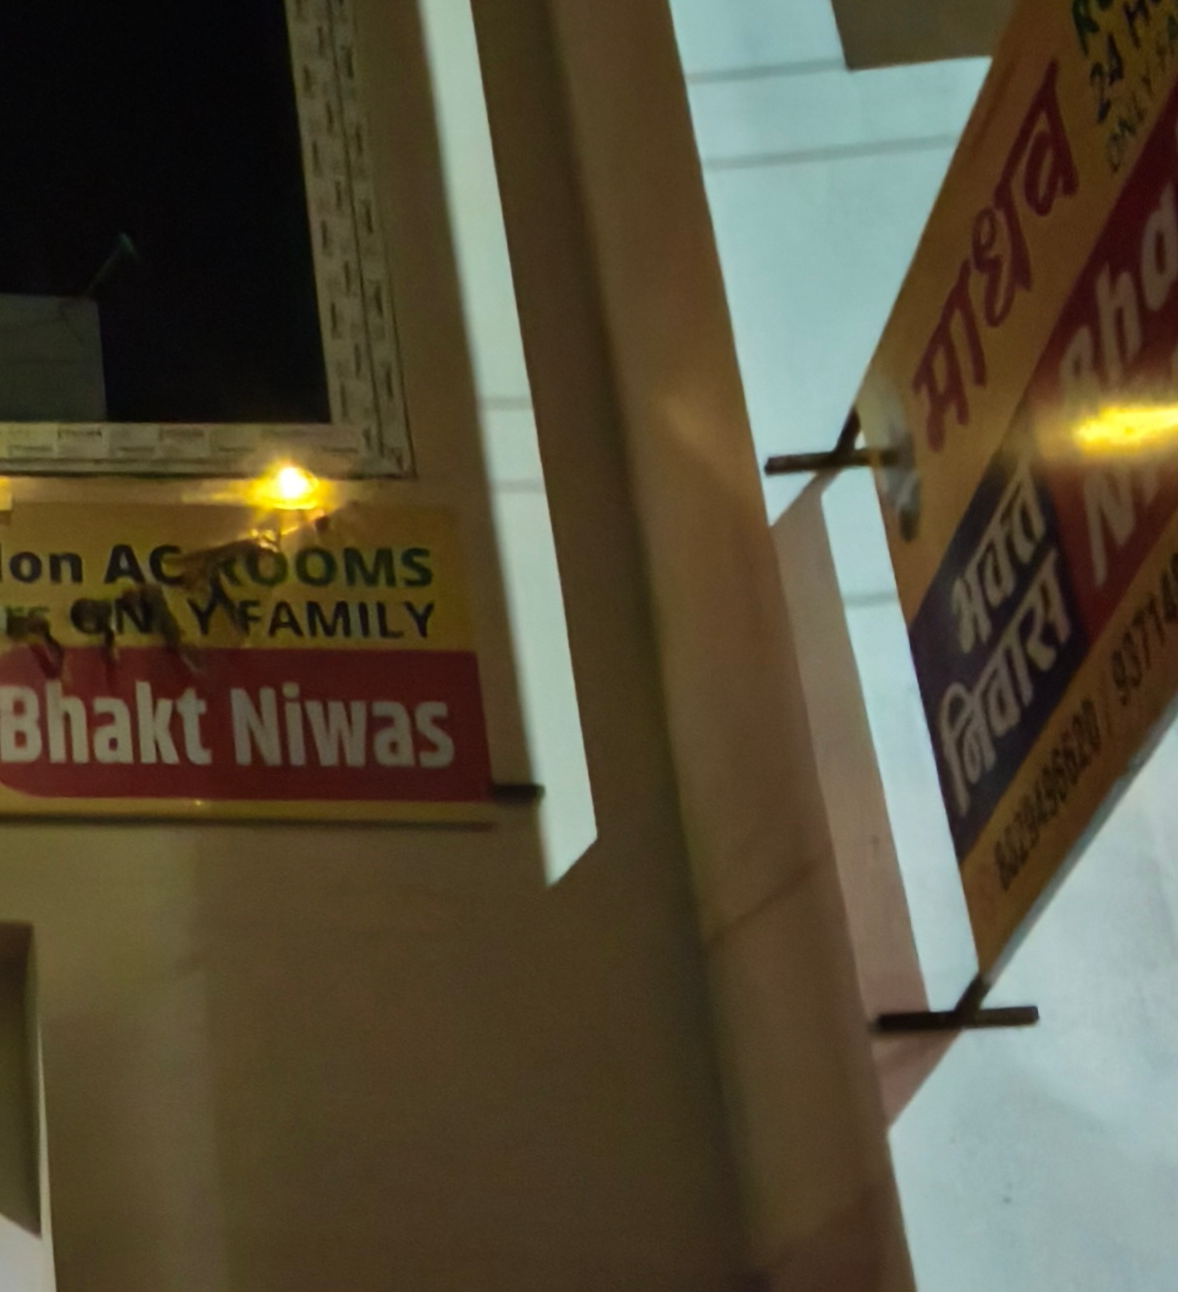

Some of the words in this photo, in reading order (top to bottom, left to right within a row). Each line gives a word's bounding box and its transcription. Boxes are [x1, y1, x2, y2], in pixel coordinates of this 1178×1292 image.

[913, 58, 1079, 454] माधव
[103, 543, 184, 585] AC
[69, 598, 219, 638] ONY
[238, 599, 436, 639] FAMILY
[232, 682, 457, 769] Niwas
[939, 548, 1072, 817] निवास
